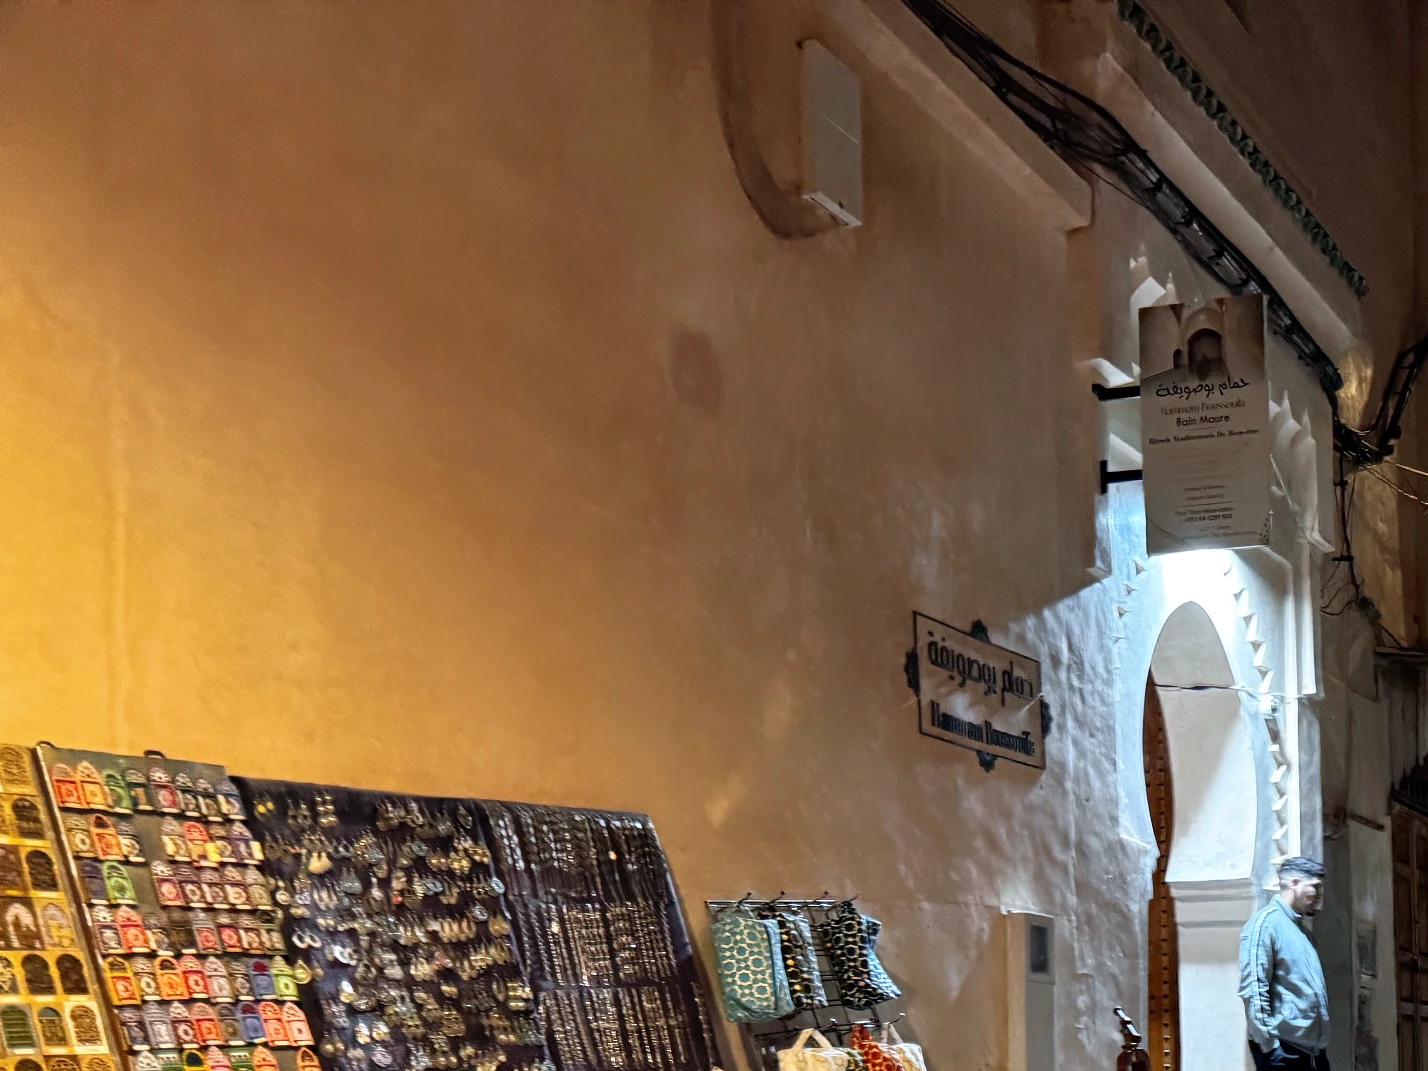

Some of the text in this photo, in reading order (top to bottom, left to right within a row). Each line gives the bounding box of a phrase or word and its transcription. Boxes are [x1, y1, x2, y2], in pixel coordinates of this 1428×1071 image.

[1155, 376, 1251, 401] حمام بوصويفة
[1176, 413, 1231, 427] Bain Maure
[927, 630, 1034, 707] حمام بوصويفة
[930, 700, 984, 743] Hammam
